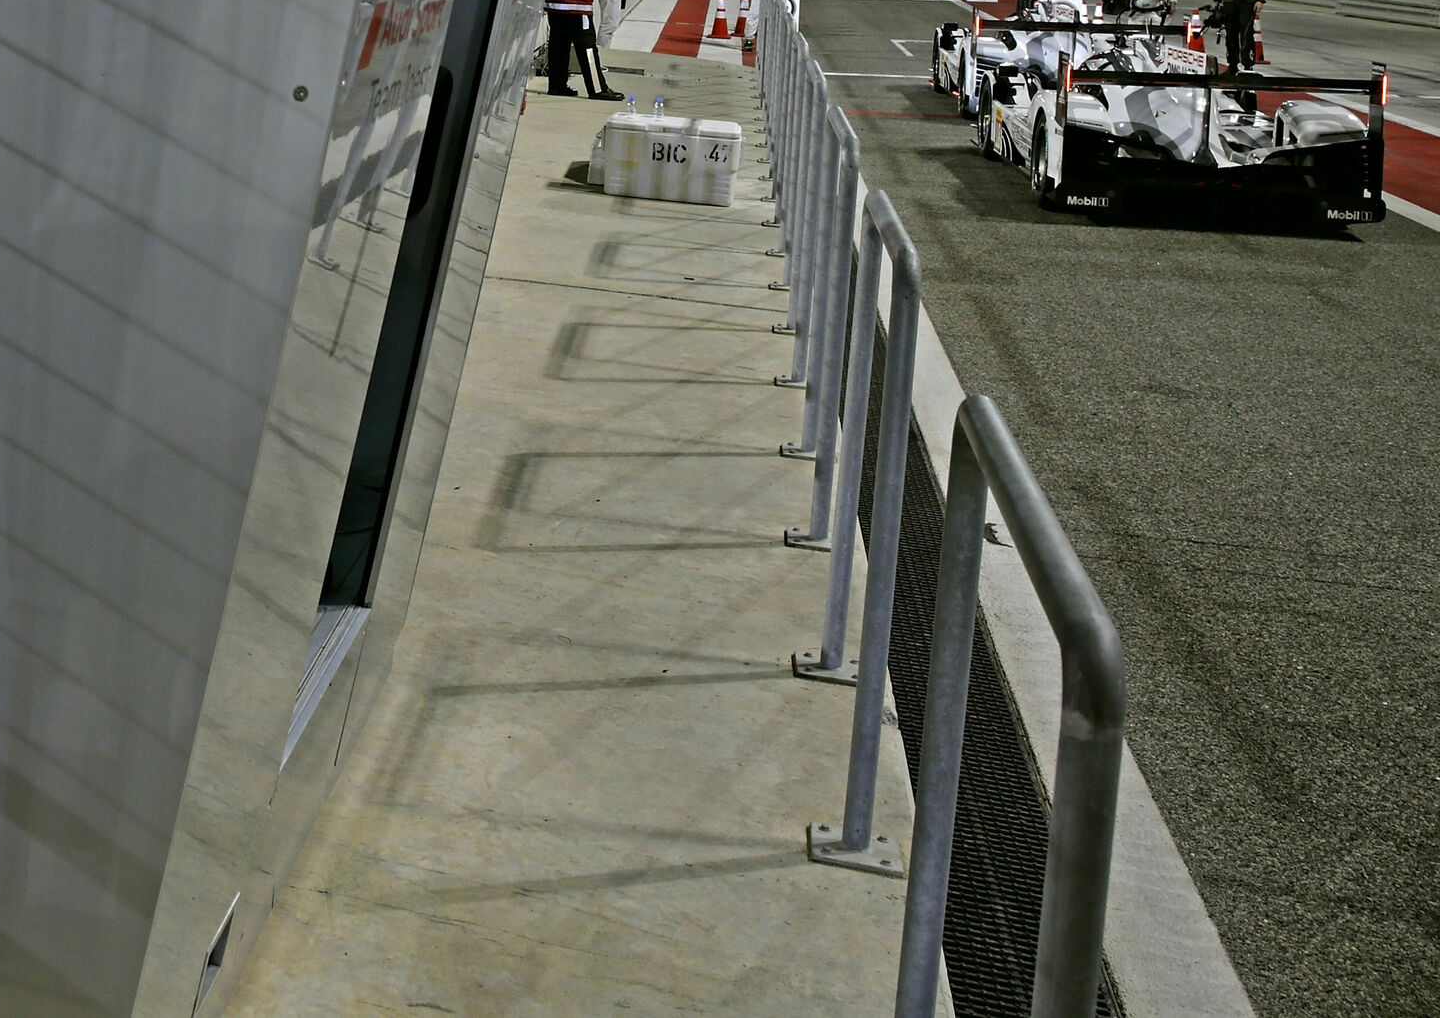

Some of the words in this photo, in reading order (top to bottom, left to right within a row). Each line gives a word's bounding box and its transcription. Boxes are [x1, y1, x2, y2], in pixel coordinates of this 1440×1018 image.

[1167, 48, 1204, 68] PORSCHE
[652, 142, 687, 164] BIC
[1066, 195, 1097, 207] Mobil
[1327, 209, 1360, 221] Mobil
